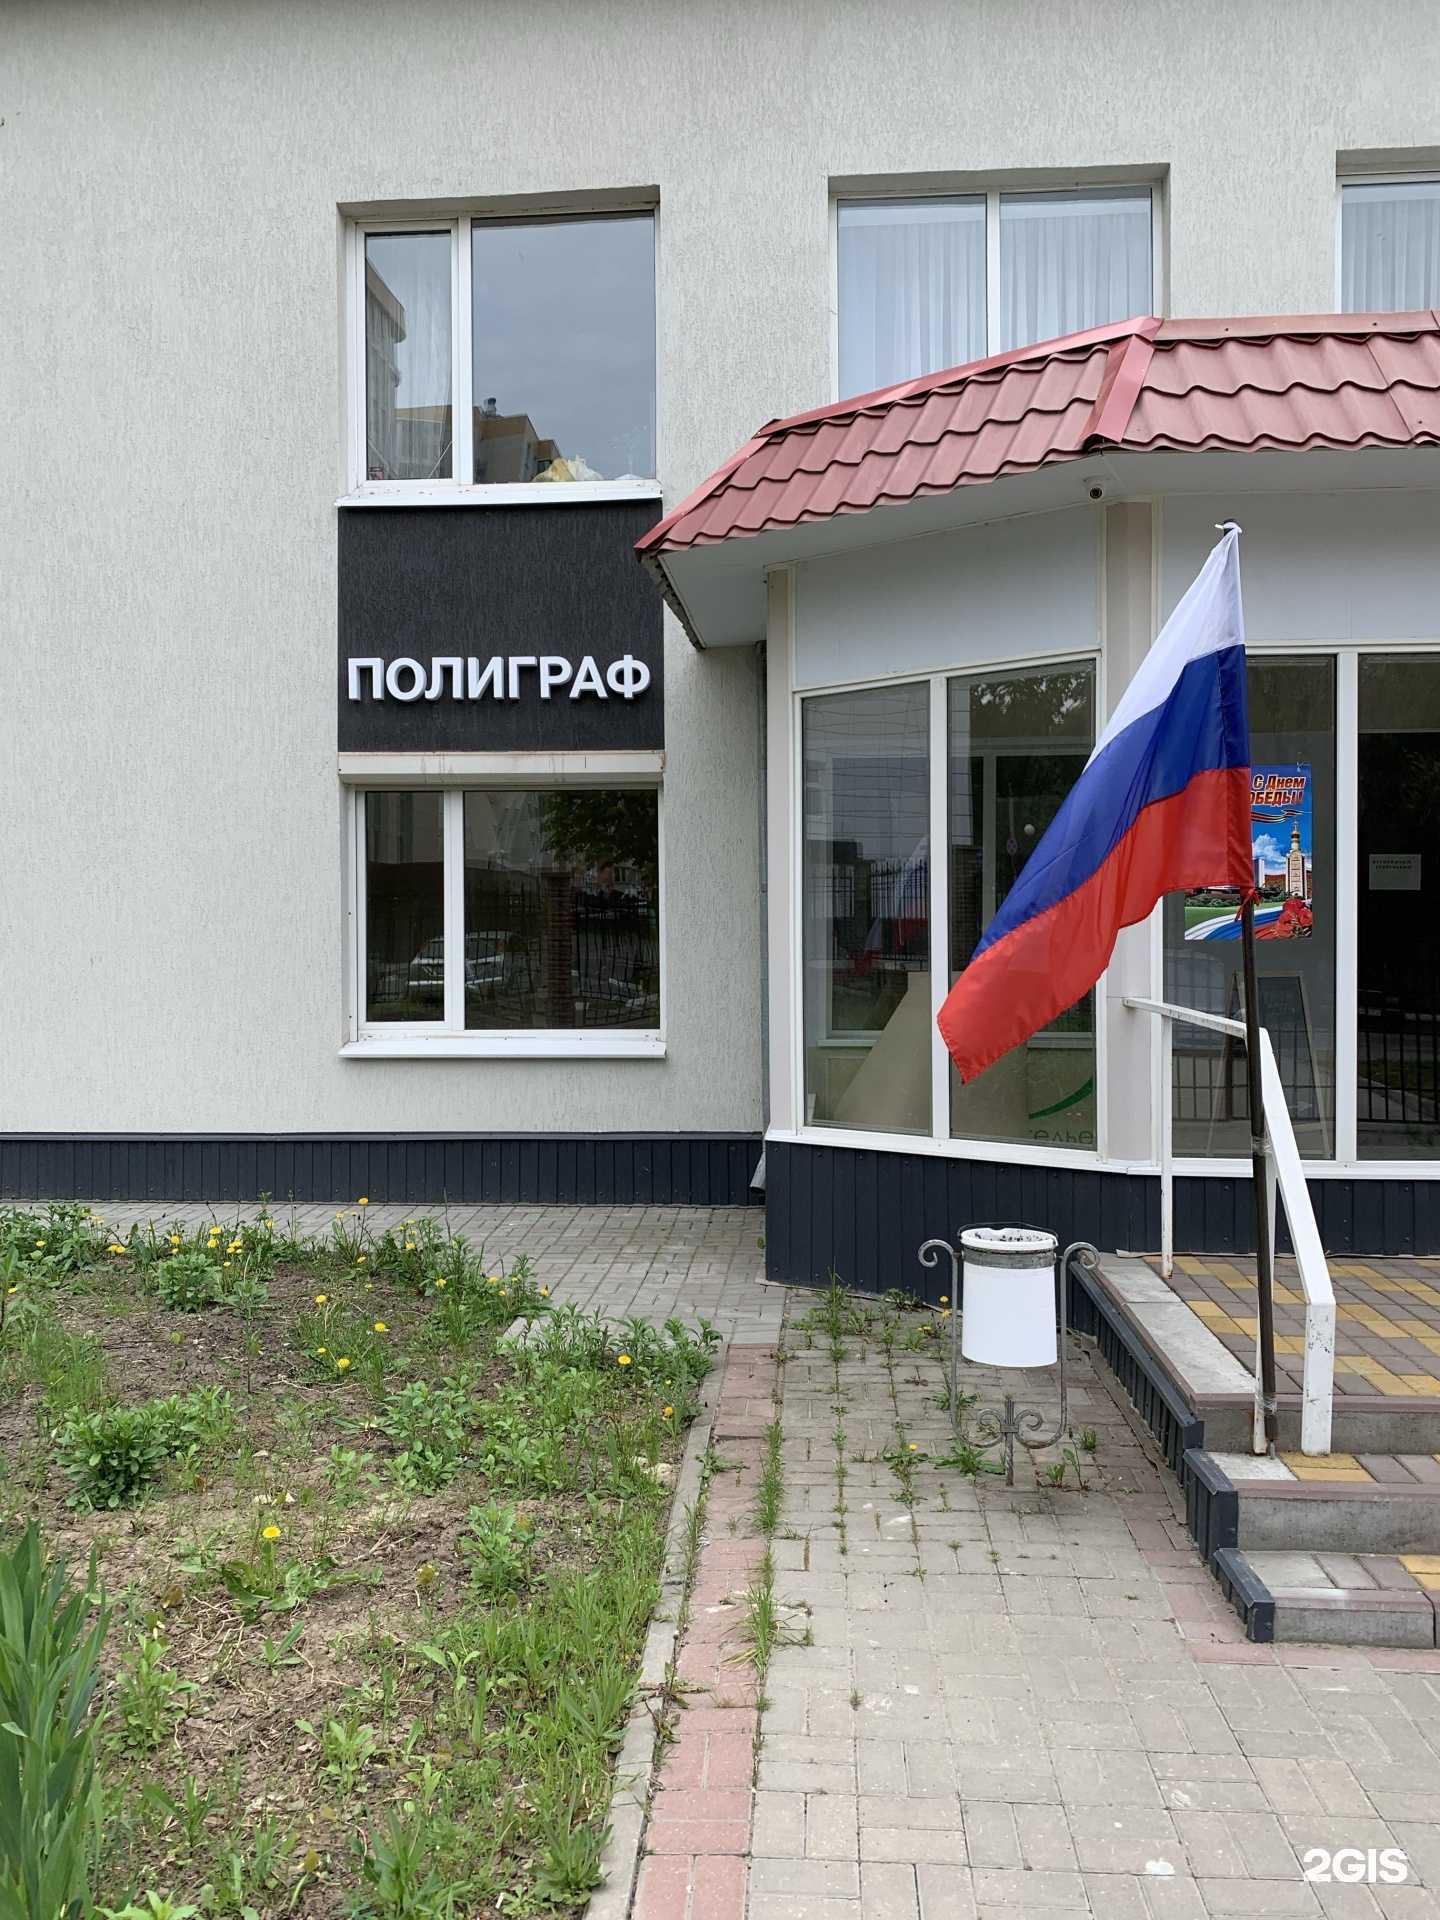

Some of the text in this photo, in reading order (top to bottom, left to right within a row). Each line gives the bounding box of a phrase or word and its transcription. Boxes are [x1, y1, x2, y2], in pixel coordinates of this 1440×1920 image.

[347, 654, 651, 702] ПОЛИГРАФ
[1252, 774, 1306, 791] С Днем
[1249, 790, 1304, 807] ОБЕДЫ!
